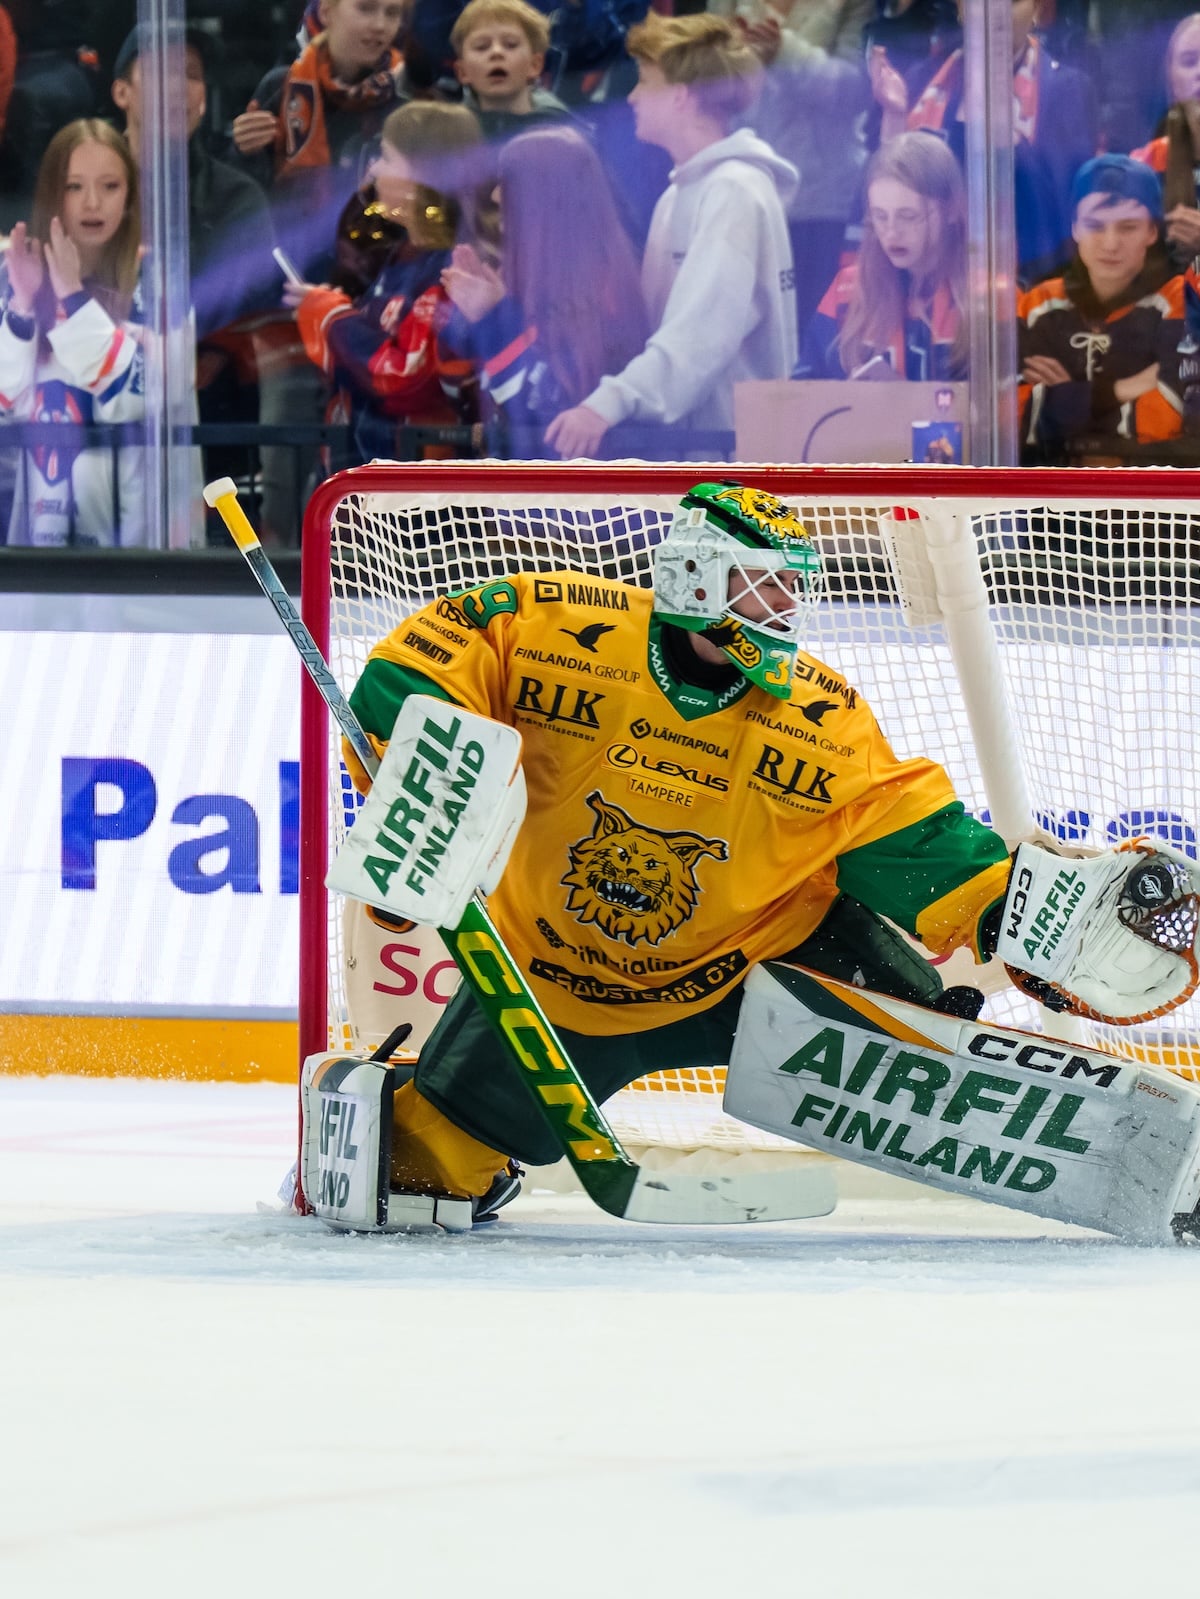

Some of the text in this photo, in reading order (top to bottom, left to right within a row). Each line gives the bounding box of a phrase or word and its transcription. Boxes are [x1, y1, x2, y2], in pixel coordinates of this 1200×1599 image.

[567, 583, 630, 611] NAVAKKA
[416, 616, 469, 649] KINNASKOSKI
[514, 647, 641, 683] FINLANDIA GROUP
[514, 676, 606, 729] RJK
[678, 695, 709, 707] CCM
[653, 727, 729, 759] LÄHITAPIOLA
[745, 710, 856, 758] FINLANDIA GROUP
[630, 779, 694, 807] TAMPERE
[641, 755, 730, 792] LEXUS
[752, 743, 837, 804] RJK
[362, 716, 462, 897] AIRFIL
[405, 740, 485, 896] FINLAND
[1006, 867, 1033, 940] CCM
[1022, 868, 1079, 961] AIRFIL
[1041, 880, 1086, 961] FINLAND
[456, 930, 619, 1163] CCM
[967, 1032, 1122, 1088] CCM
[779, 1026, 1091, 1155] AIRFIL
[791, 1092, 1057, 1193] FINLAND
